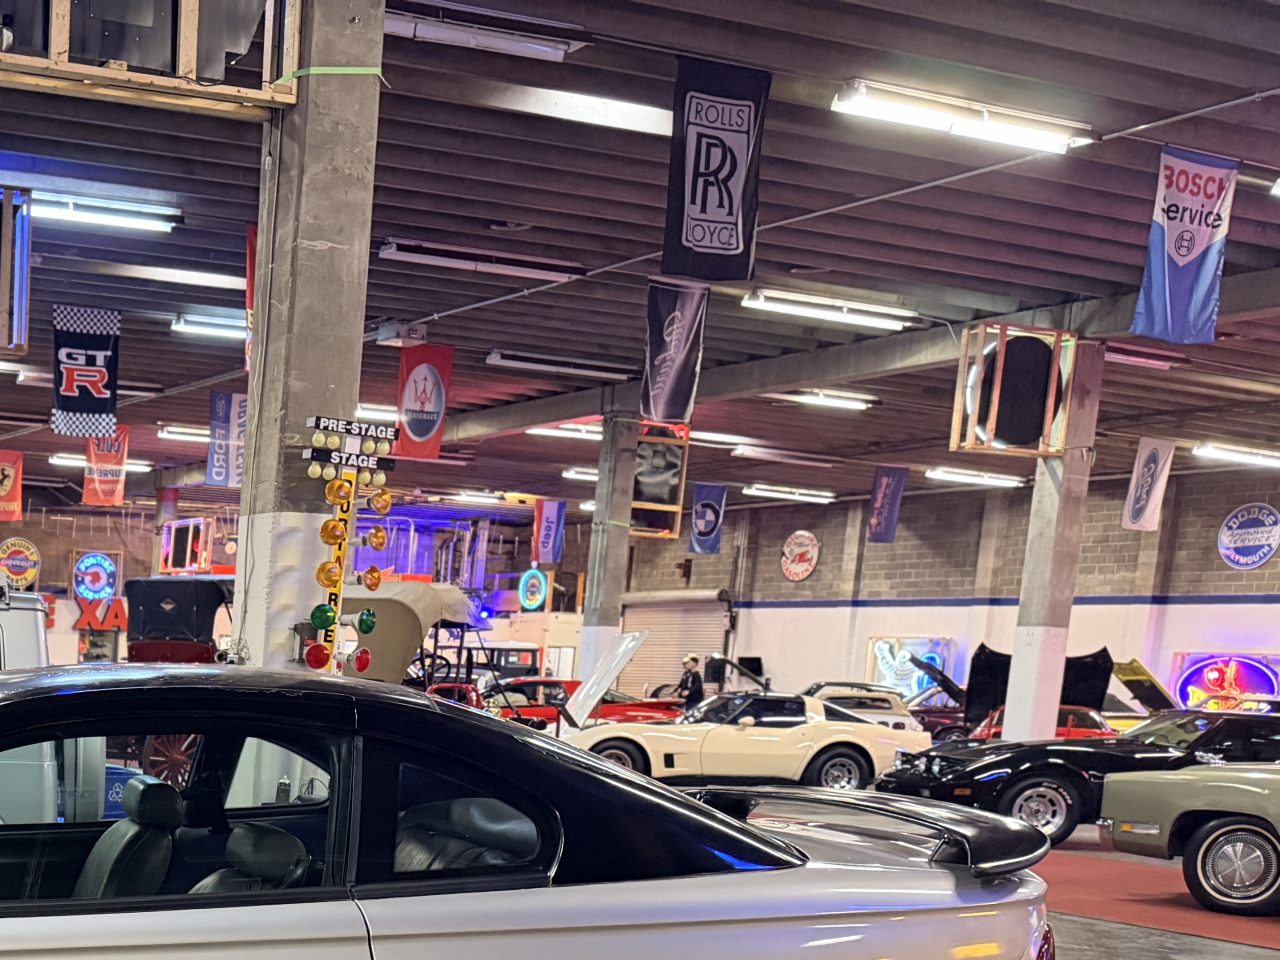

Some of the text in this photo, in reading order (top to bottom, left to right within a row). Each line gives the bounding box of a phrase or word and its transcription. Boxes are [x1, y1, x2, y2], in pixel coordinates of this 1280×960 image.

[695, 102, 745, 127] ROLLS
[1161, 194, 1223, 230] ervice
[689, 222, 735, 246] OYCE
[58, 347, 112, 366] GT
[60, 364, 111, 398] R
[319, 417, 396, 440] PRE-STAGE
[330, 451, 378, 469] STAGE
[1227, 508, 1276, 530] DODGE
[541, 516, 555, 549] Jeep
[1, 541, 35, 556] GENUINE
[0, 558, 35, 567] CHEVROLET
[79, 556, 114, 573] PONTIAC
